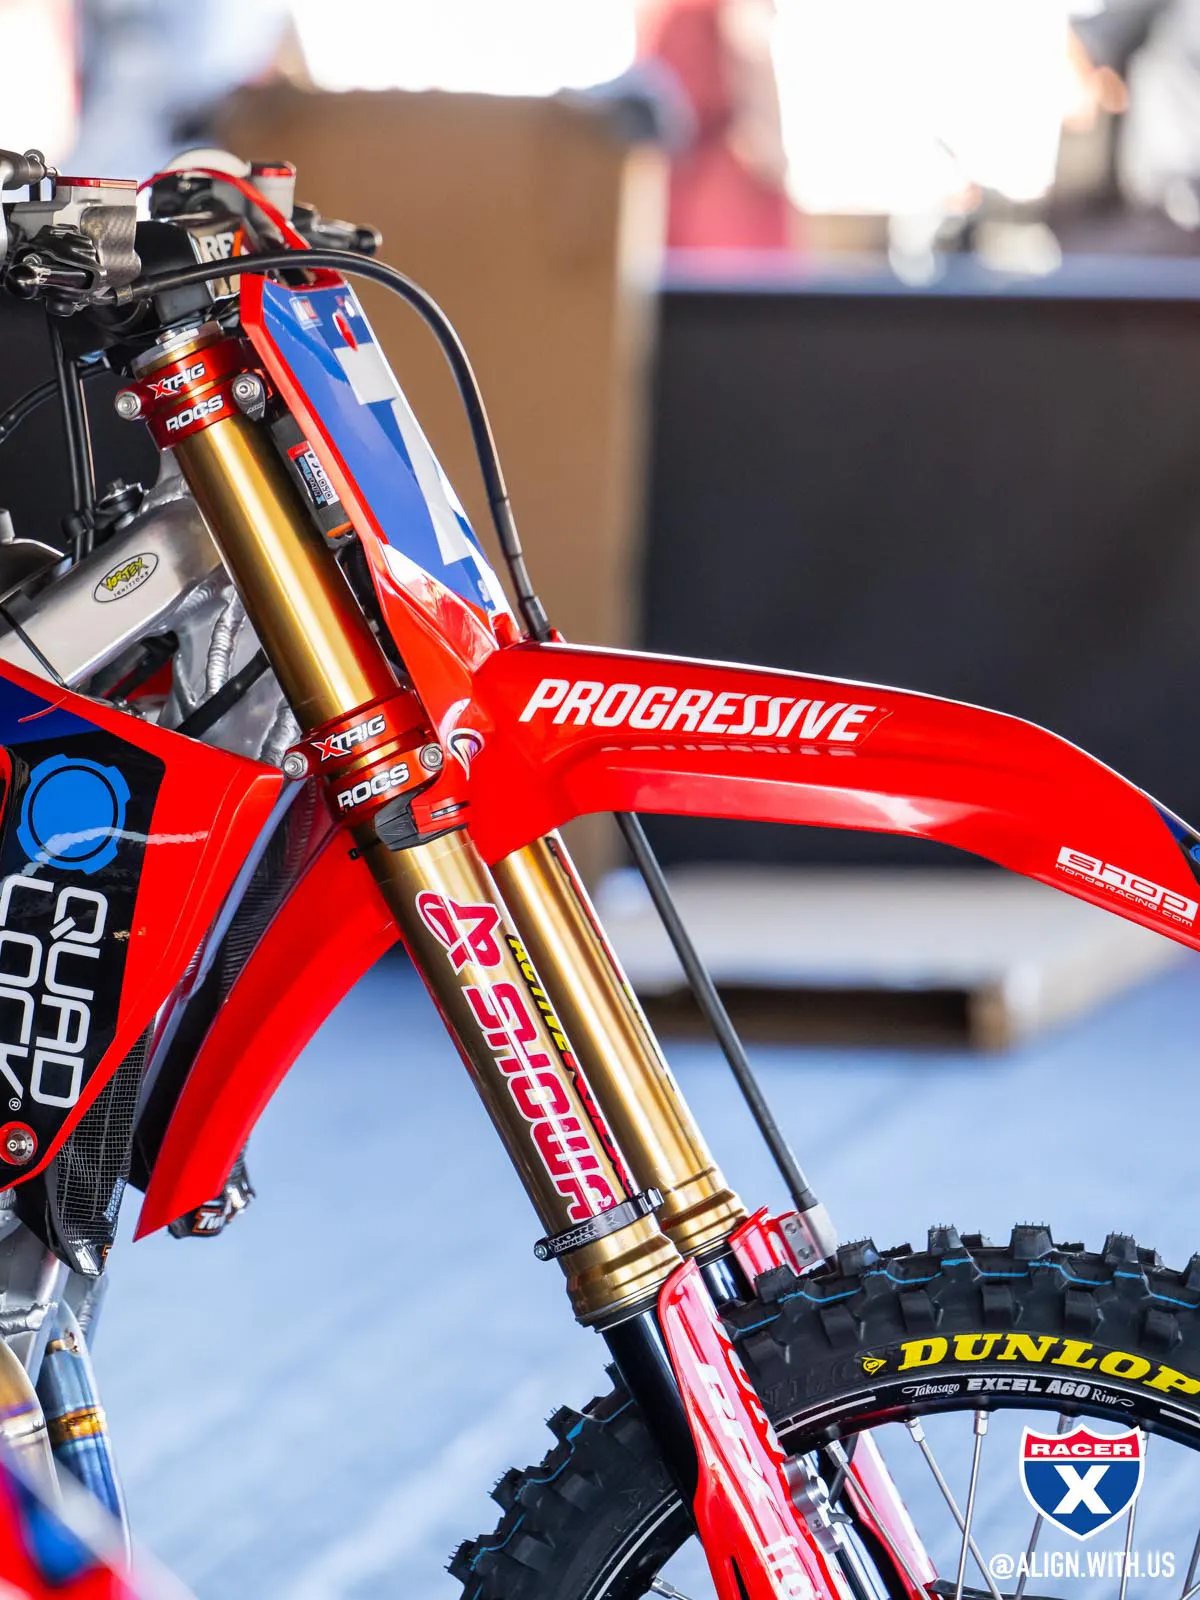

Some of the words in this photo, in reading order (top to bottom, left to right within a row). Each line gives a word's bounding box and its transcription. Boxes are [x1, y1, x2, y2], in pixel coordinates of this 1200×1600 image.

[147, 362, 206, 399] XTRIG
[101, 556, 149, 592] VORTEX
[517, 678, 877, 743] PROGRESSIVE
[311, 714, 387, 762] XTRIG
[337, 763, 410, 811] ROCS
[29, 886, 108, 1109] QUAD
[461, 980, 619, 1225] SHOWA
[897, 1333, 1200, 1395] DUNLOP
[908, 1382, 960, 1398] Takasago
[966, 1378, 1043, 1393] EXCEL
[1046, 1380, 1090, 1397] A60
